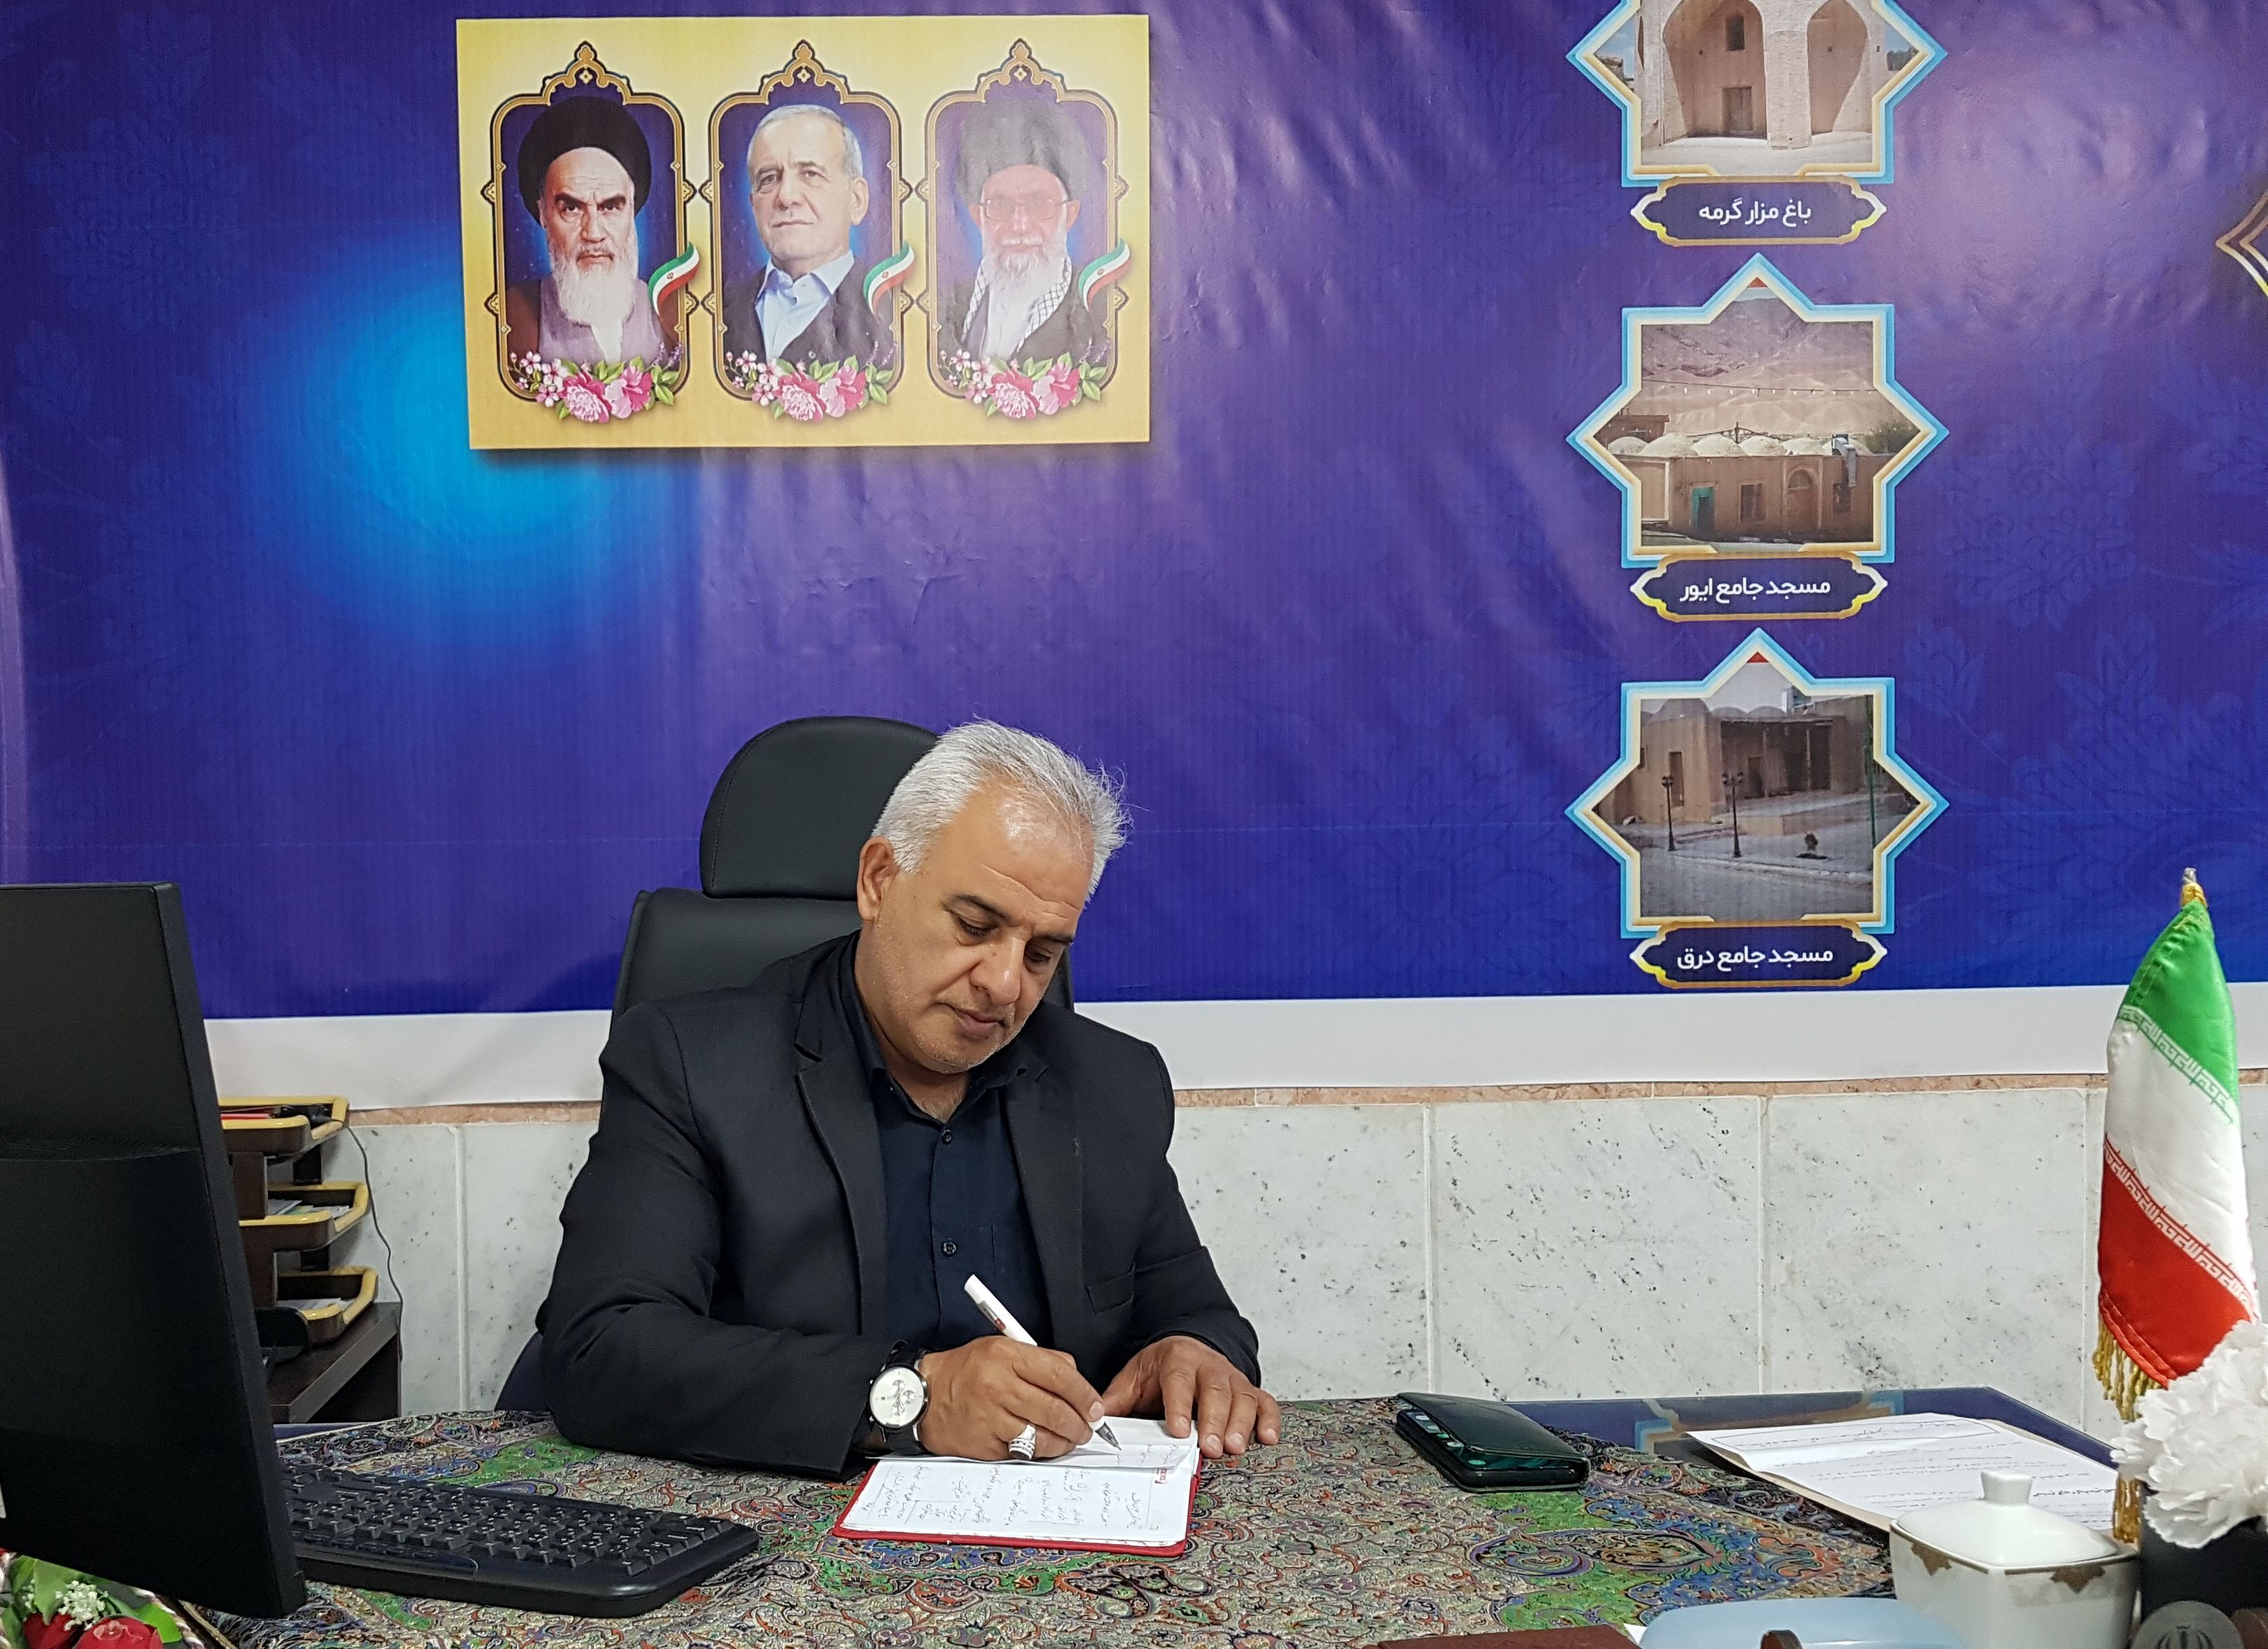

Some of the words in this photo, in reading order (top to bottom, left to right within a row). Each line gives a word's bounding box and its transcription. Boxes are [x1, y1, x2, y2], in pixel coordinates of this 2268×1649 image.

[1699, 197, 1742, 225] گرمه
[1744, 201, 1779, 225] مزار
[1782, 199, 1812, 227] باغ
[1715, 577, 1764, 604] جامع
[1765, 580, 1831, 601] مسجد
[1676, 948, 1714, 969] درق
[1717, 946, 1766, 972] جامع
[1768, 949, 1833, 969] مسجد
